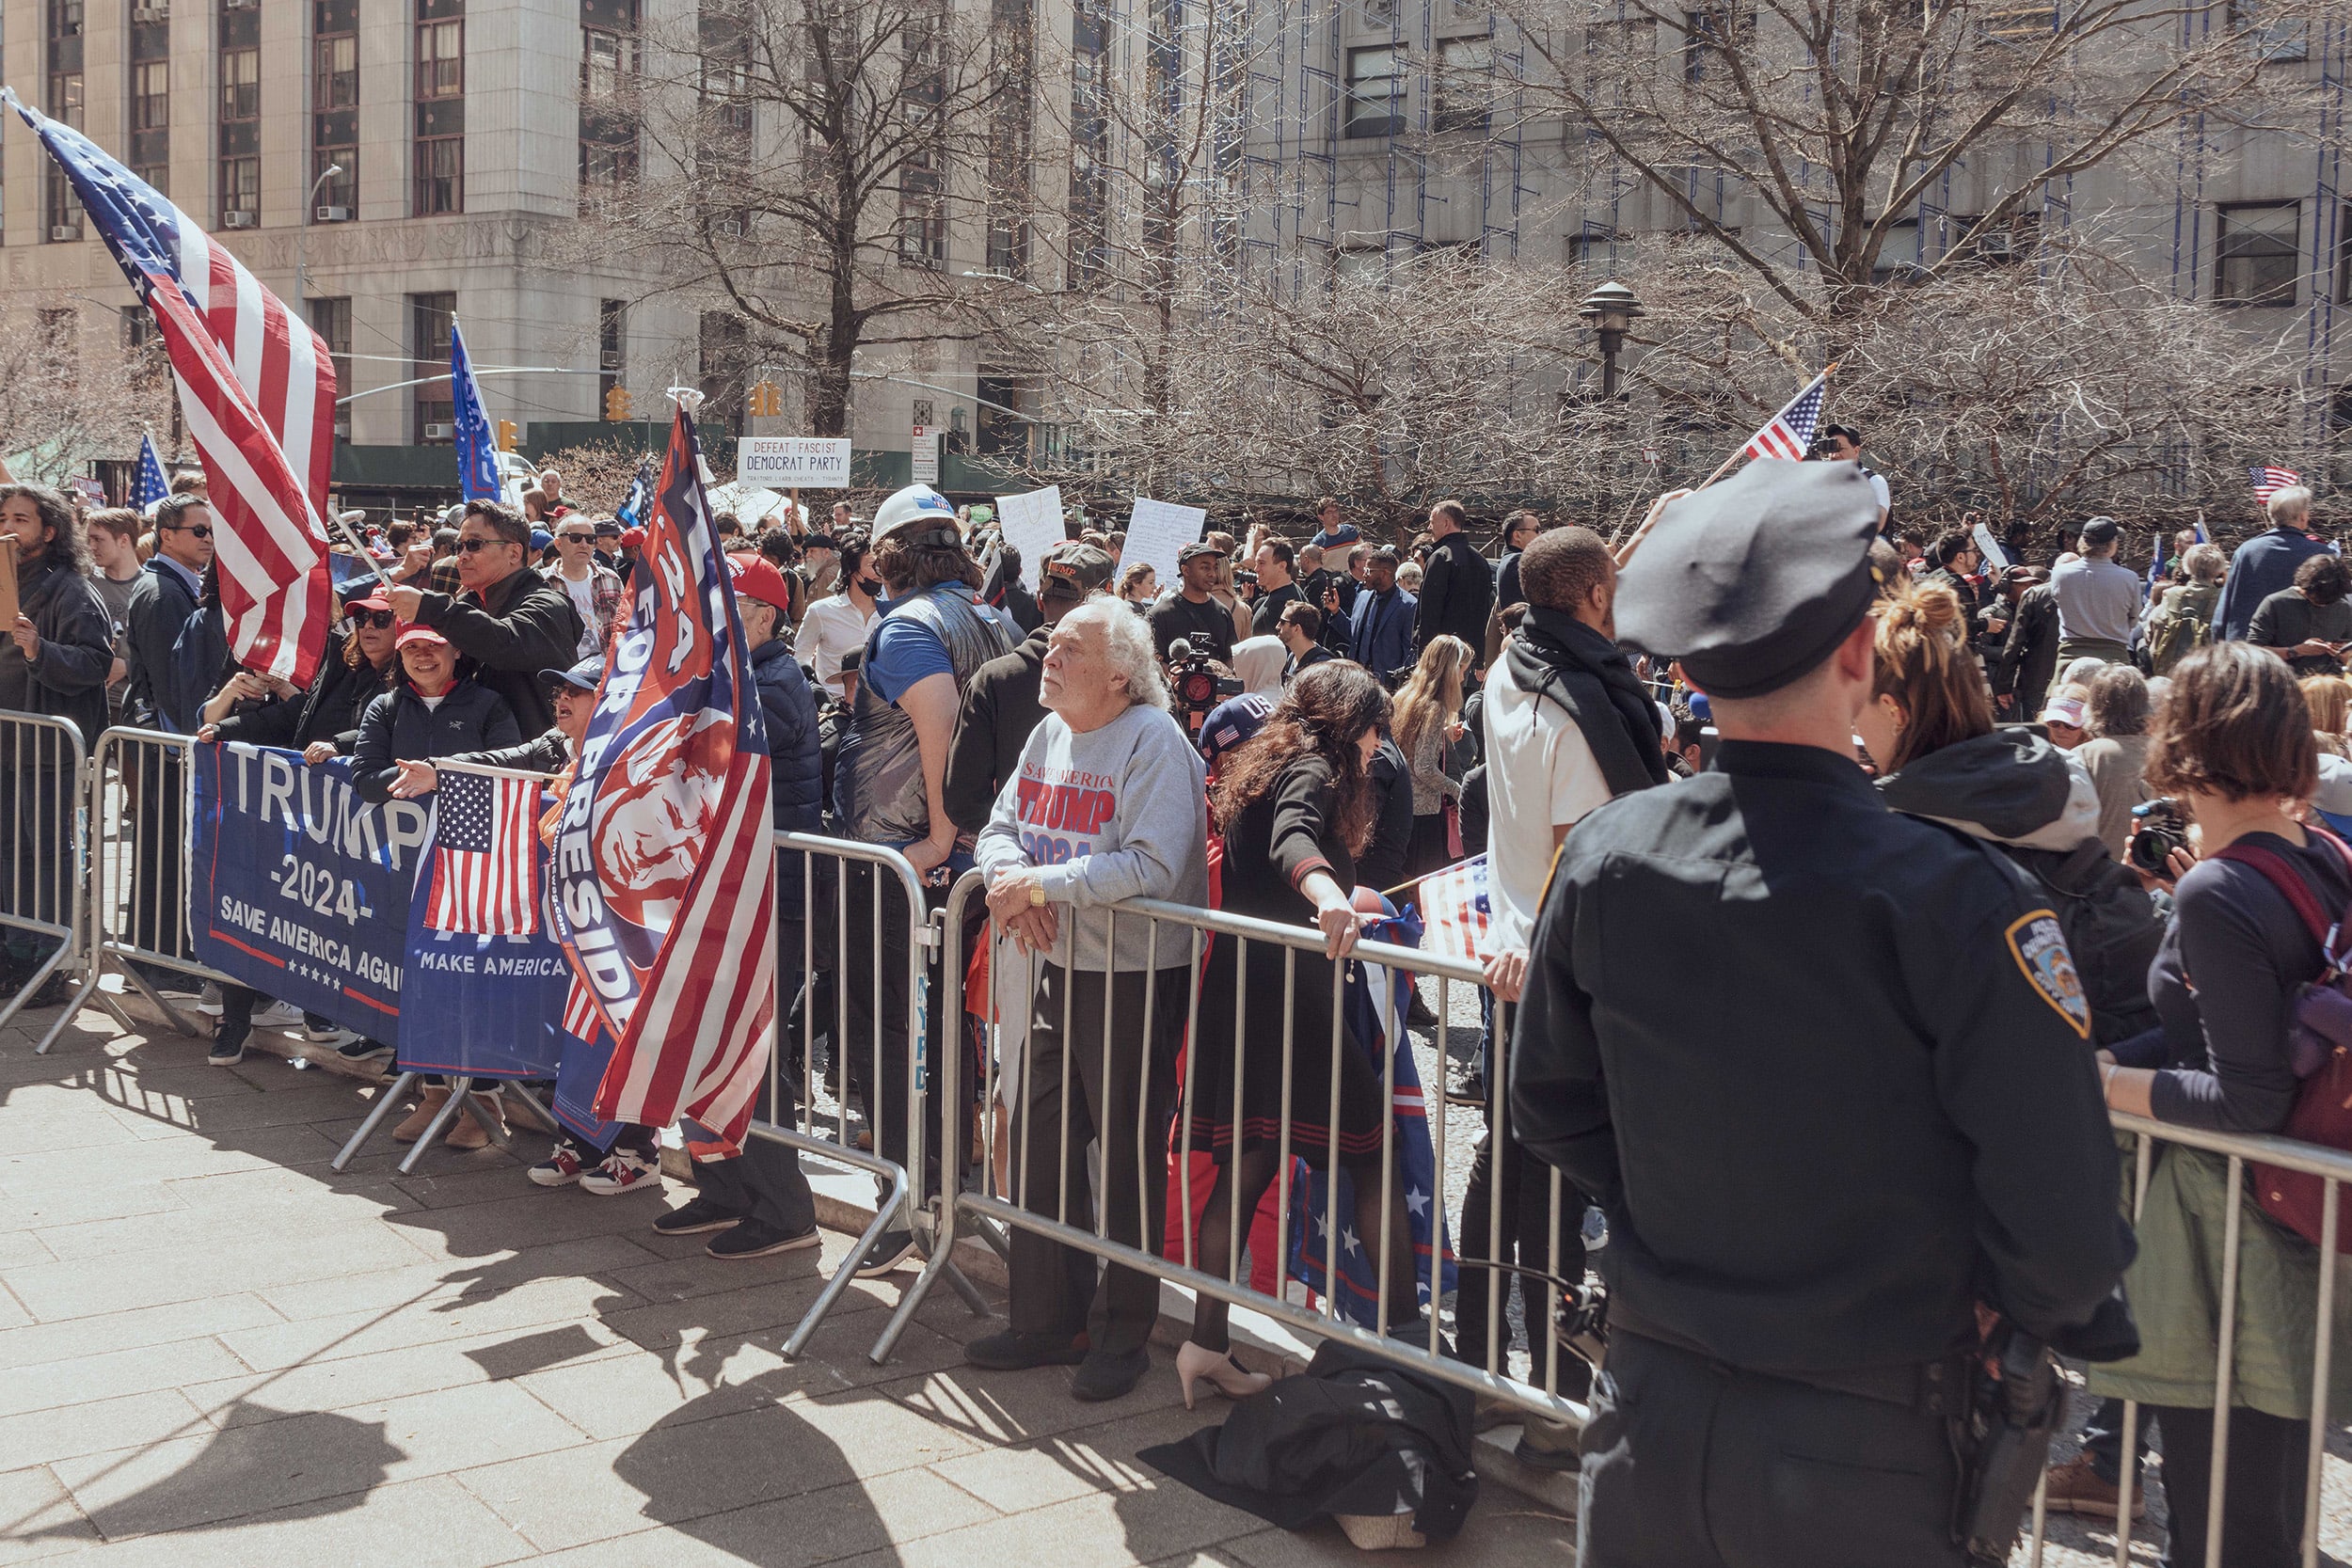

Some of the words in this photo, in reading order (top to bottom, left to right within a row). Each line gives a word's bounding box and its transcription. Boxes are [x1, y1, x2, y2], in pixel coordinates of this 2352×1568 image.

[746, 456, 803, 471] DEMOCRAT
[809, 456, 843, 471] PARTY
[754, 442, 790, 453] DEFEAT
[799, 442, 837, 453] FASCIST
[594, 584, 656, 720] FOR
[227, 740, 428, 872] TRUMP
[1016, 777, 1117, 836] TRUMP
[270, 853, 373, 927] -2024-
[220, 895, 266, 935] SAVE
[269, 914, 352, 973] AMERICA
[355, 951, 405, 992] AGAI
[420, 951, 475, 974] MAKE
[483, 956, 568, 977] AMERICA
